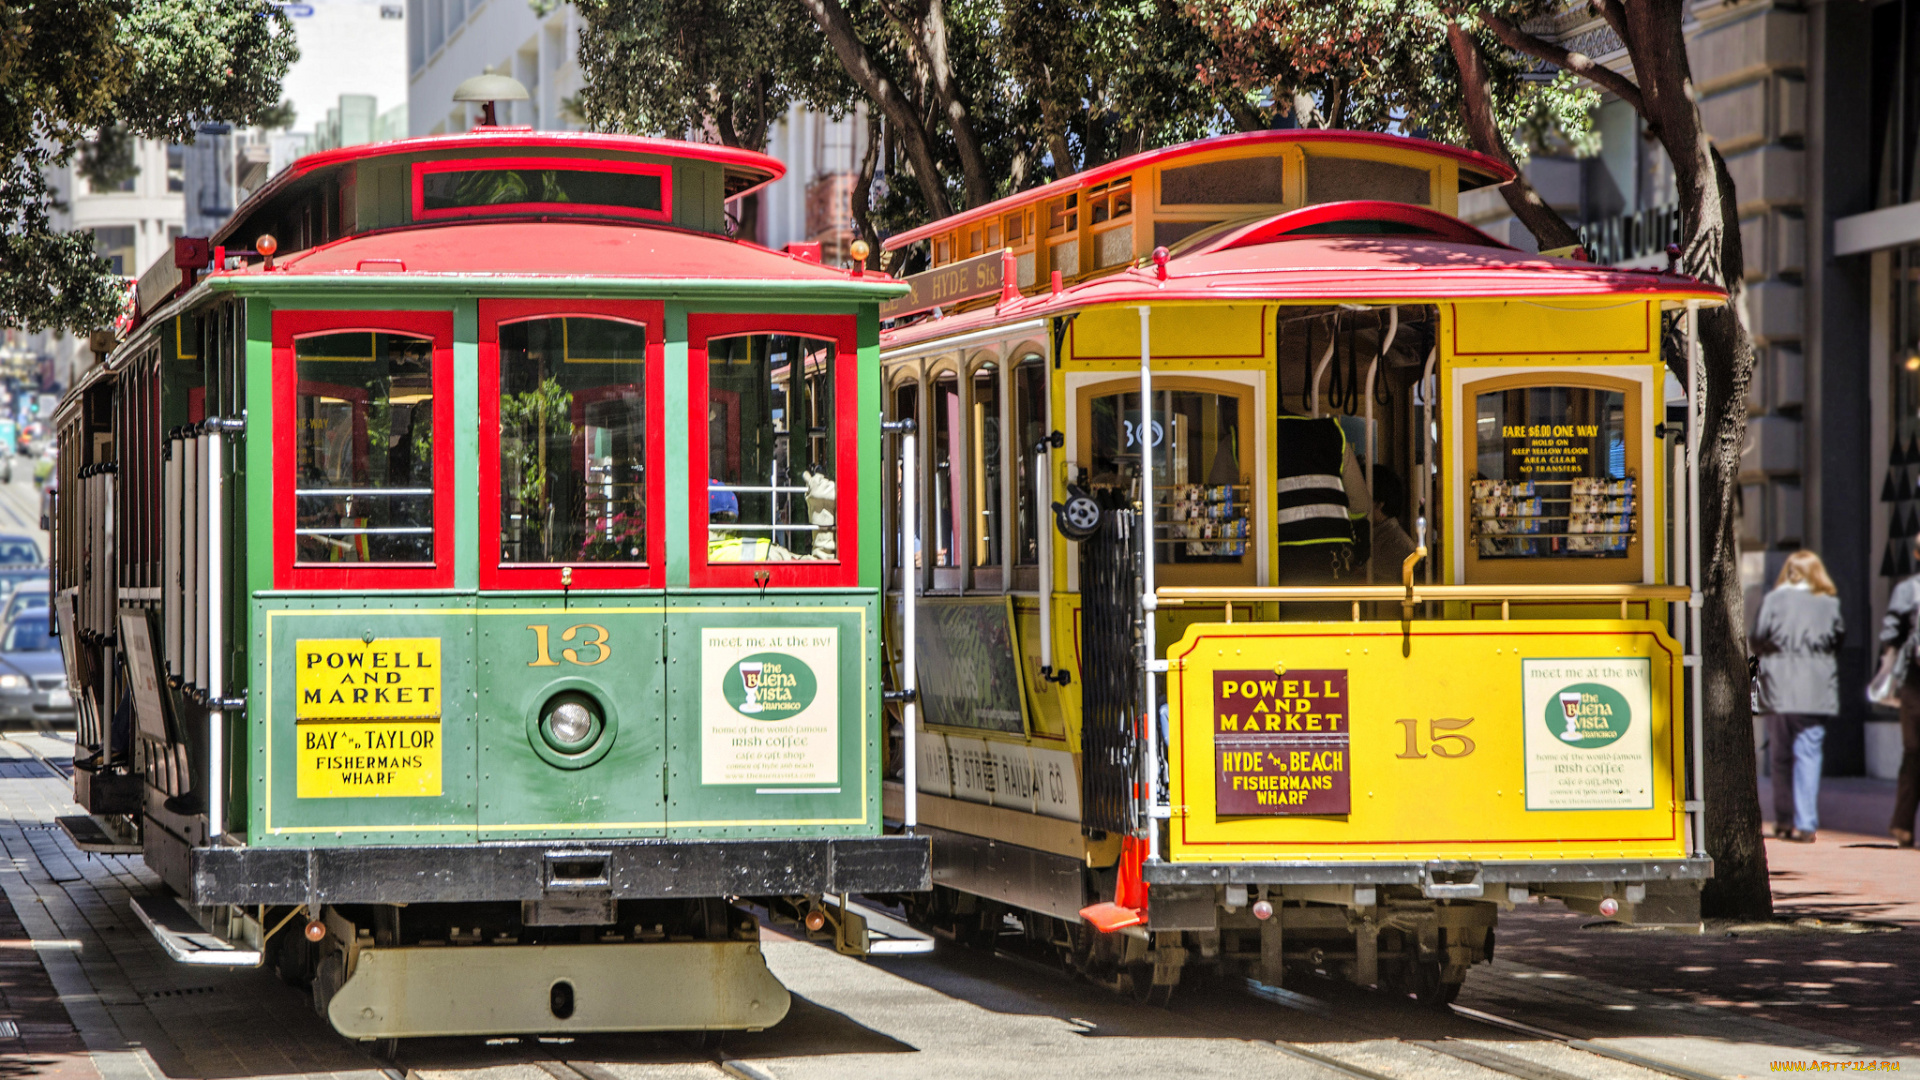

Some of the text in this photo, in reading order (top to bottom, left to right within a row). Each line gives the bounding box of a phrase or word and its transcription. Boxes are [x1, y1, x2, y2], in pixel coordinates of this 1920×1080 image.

[932, 266, 969, 300] HYDE
[976, 263, 998, 288] Sts.
[309, 418, 329, 429] WAY
[1502, 425, 1526, 438] FARE
[1552, 425, 1574, 437] ONE
[1576, 425, 1599, 437] WAY
[1555, 438, 1569, 446] ON
[1531, 447, 1562, 455] YELLOW
[1563, 447, 1589, 455] FLOOR
[1519, 465, 1533, 473] NO
[526, 623, 611, 667] 13
[787, 636, 808, 647] the
[306, 652, 432, 669] POWELL
[340, 672, 402, 685] AND
[1602, 667, 1623, 678] the
[304, 687, 434, 704] MARKET
[1221, 680, 1340, 698] POWELL
[1253, 698, 1311, 713] AND
[1220, 713, 1342, 731] MARKET
[306, 731, 338, 750] BAY
[364, 730, 434, 750] TAYLOR
[1394, 716, 1476, 759] 15
[316, 755, 422, 770] FISHERMANS
[1222, 751, 1343, 772] HYDE AND BEACH
[342, 771, 397, 785] WHARF
[1232, 775, 1332, 790] FISHERMANS
[1256, 790, 1309, 805] WHARF
